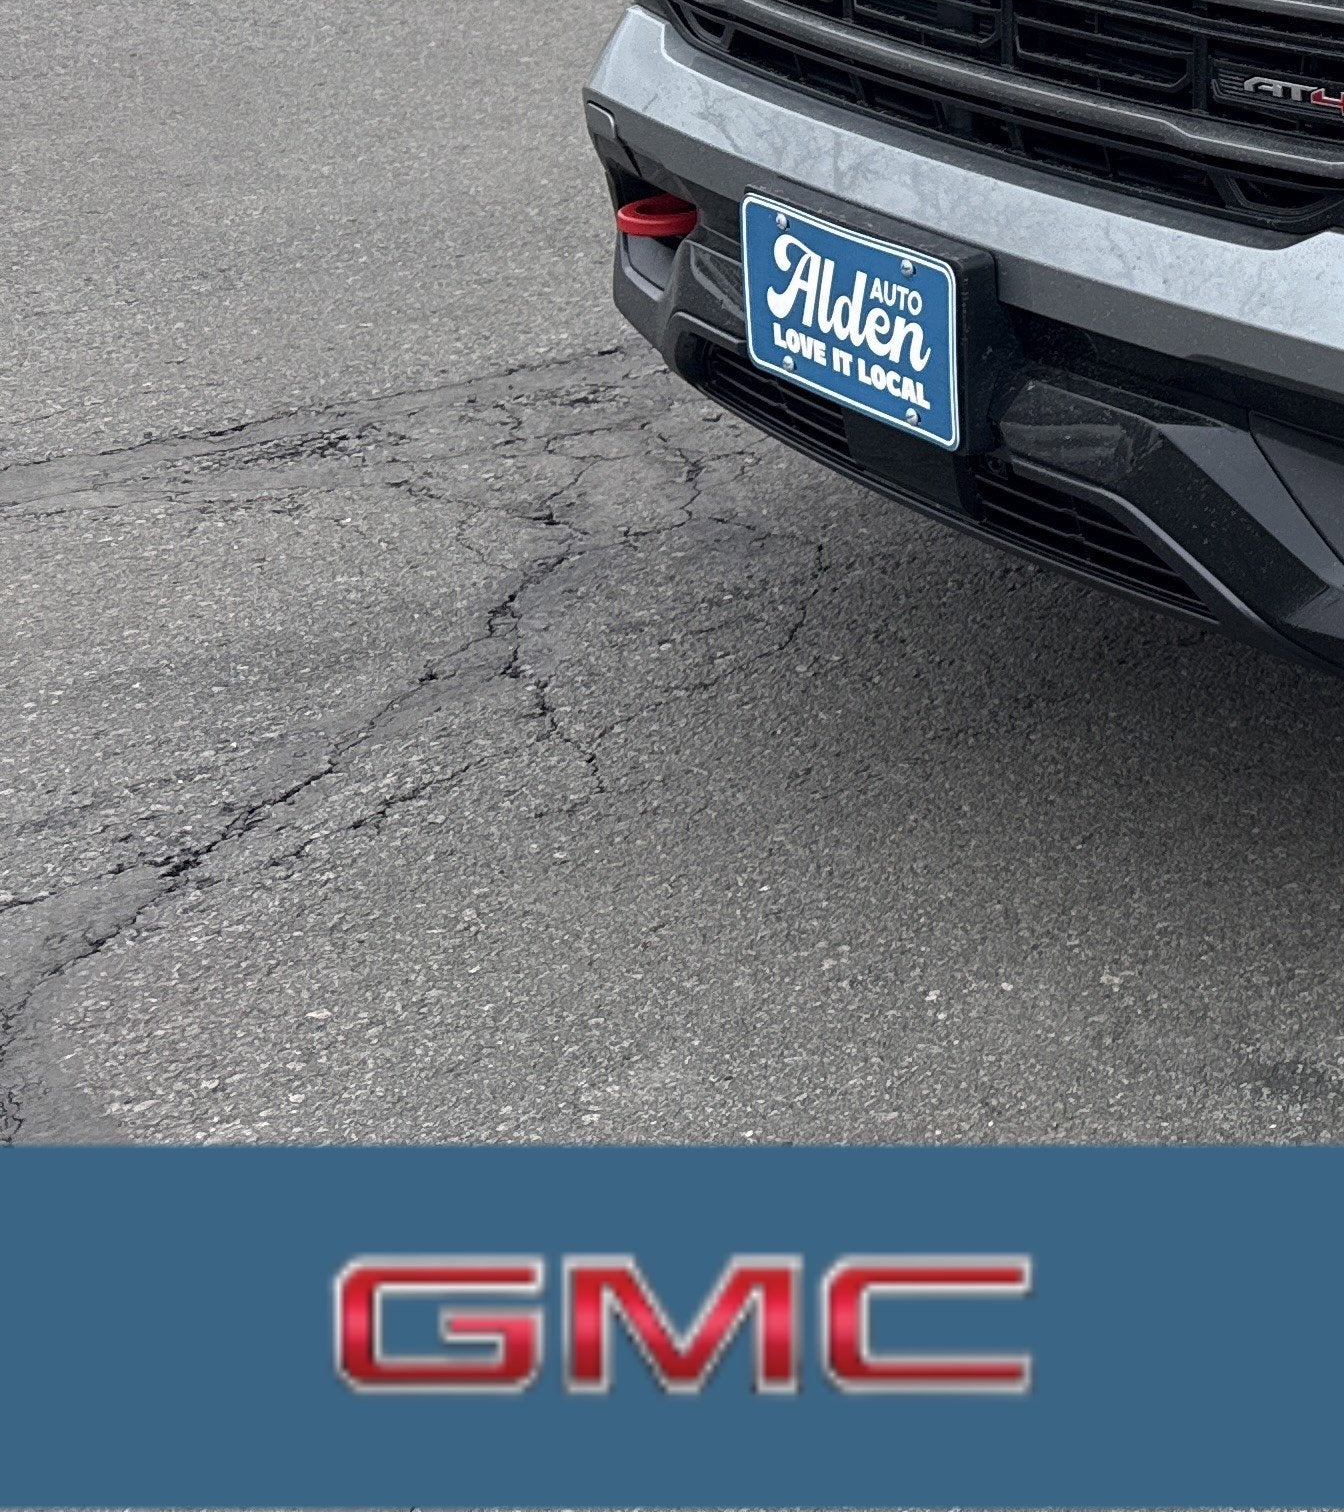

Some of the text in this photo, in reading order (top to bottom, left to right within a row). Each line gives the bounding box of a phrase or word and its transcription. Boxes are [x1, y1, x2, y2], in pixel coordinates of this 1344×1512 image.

[767, 234, 931, 371] Alden
[869, 277, 923, 316] AUTO
[773, 322, 931, 409] LOVE IT LOCAL
